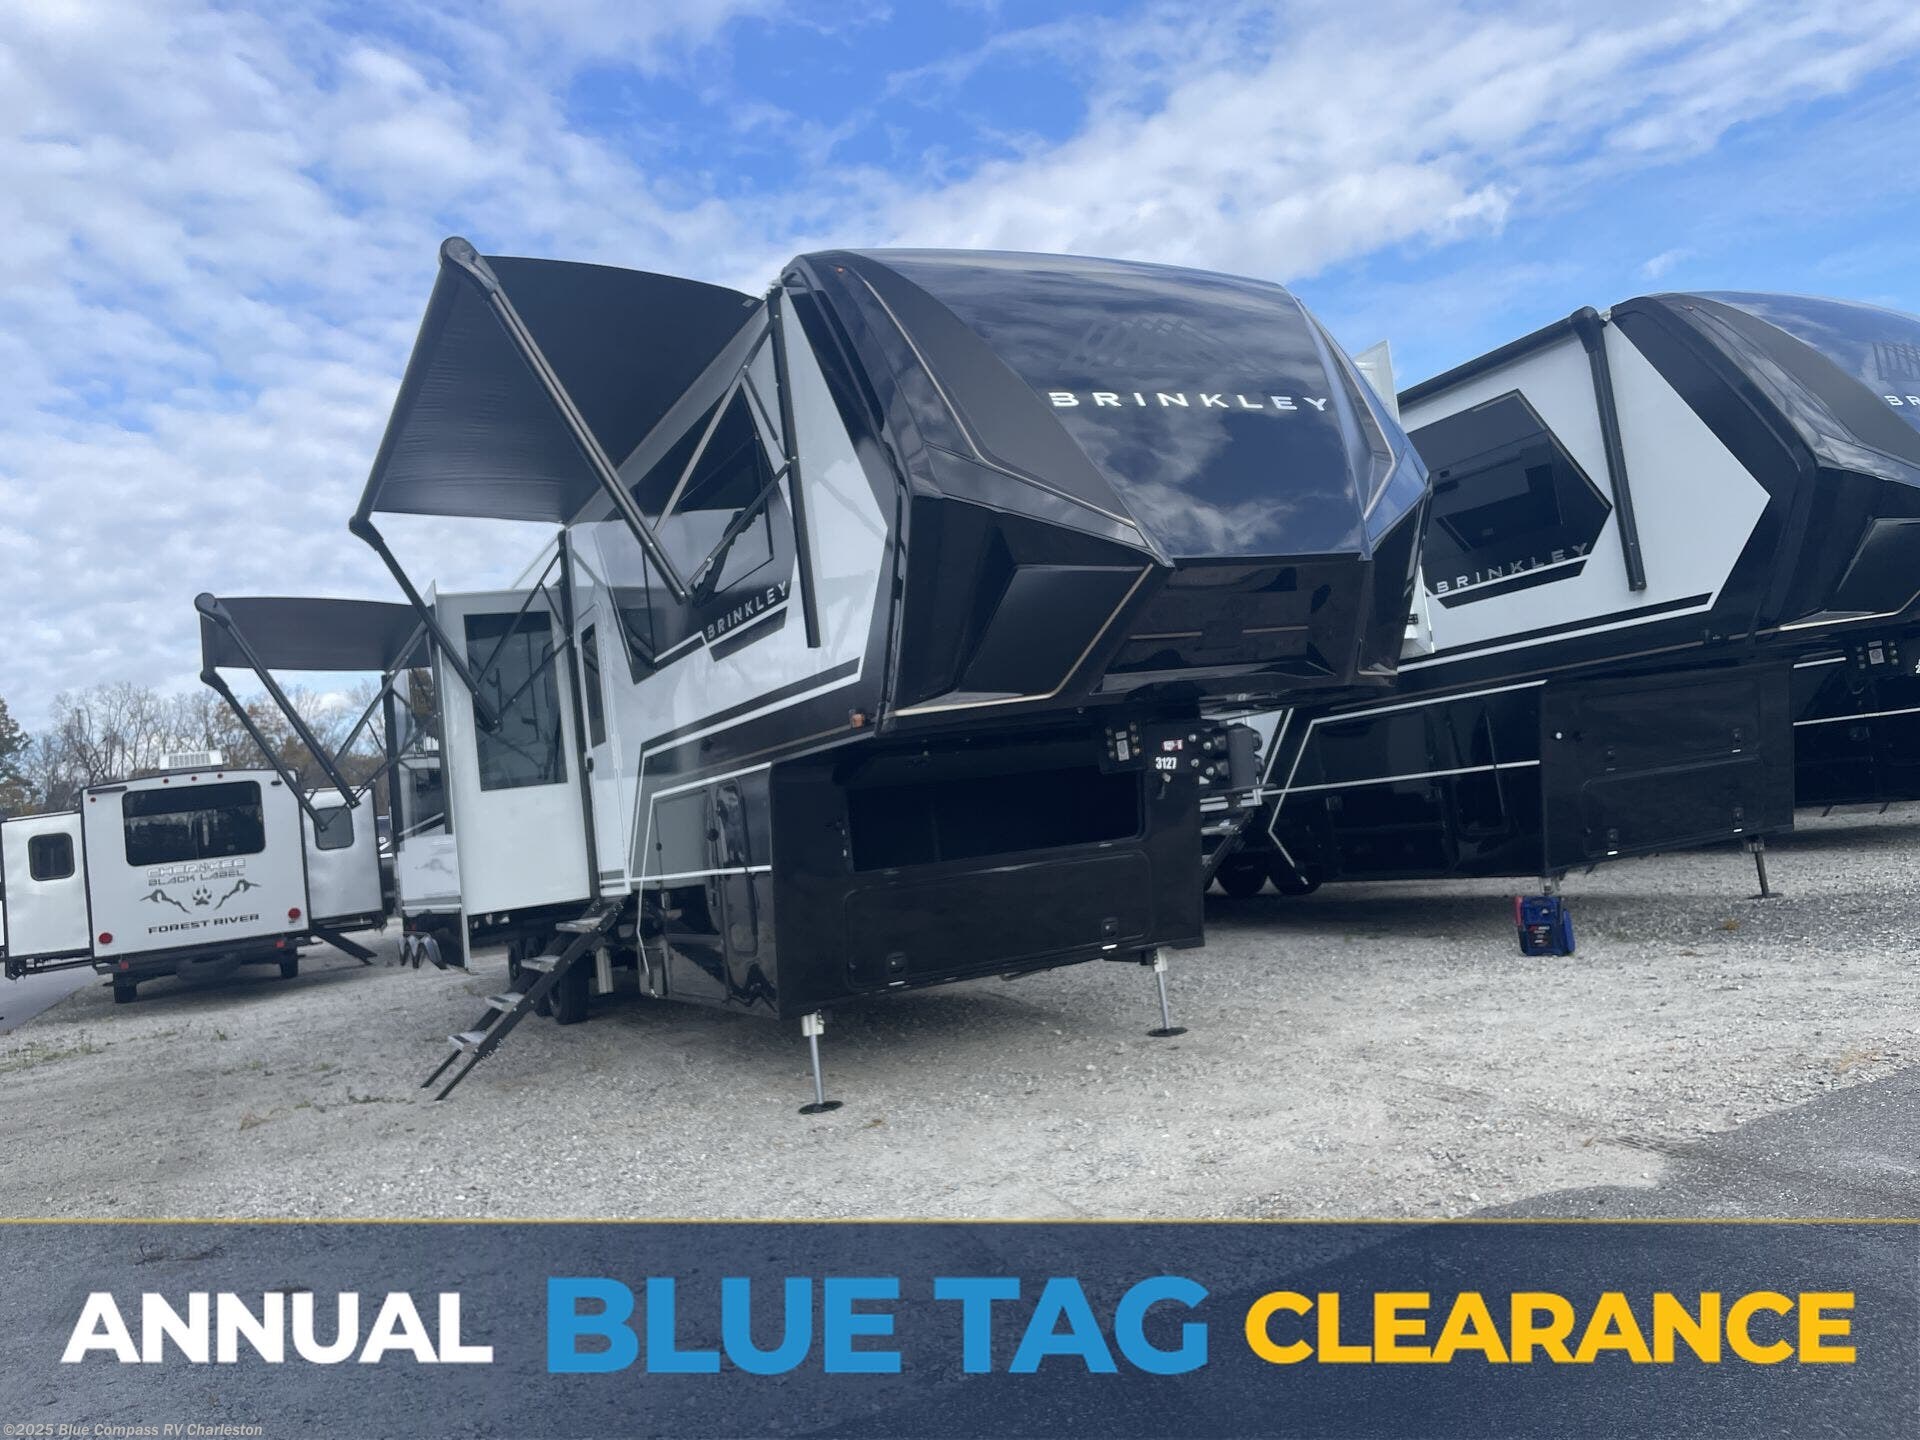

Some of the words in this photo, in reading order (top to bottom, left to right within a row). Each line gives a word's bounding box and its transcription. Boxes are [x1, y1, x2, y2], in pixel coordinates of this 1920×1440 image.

[1048, 391, 1327, 411] BRINKLEY
[1436, 542, 1588, 593] BRINKLEY
[707, 580, 786, 640] BRINKLEY
[1155, 756, 1177, 770] 3127
[148, 874, 196, 887] BLACK
[200, 869, 245, 881] LABEL
[148, 919, 210, 934] FOREST
[213, 914, 260, 926] RIVER
